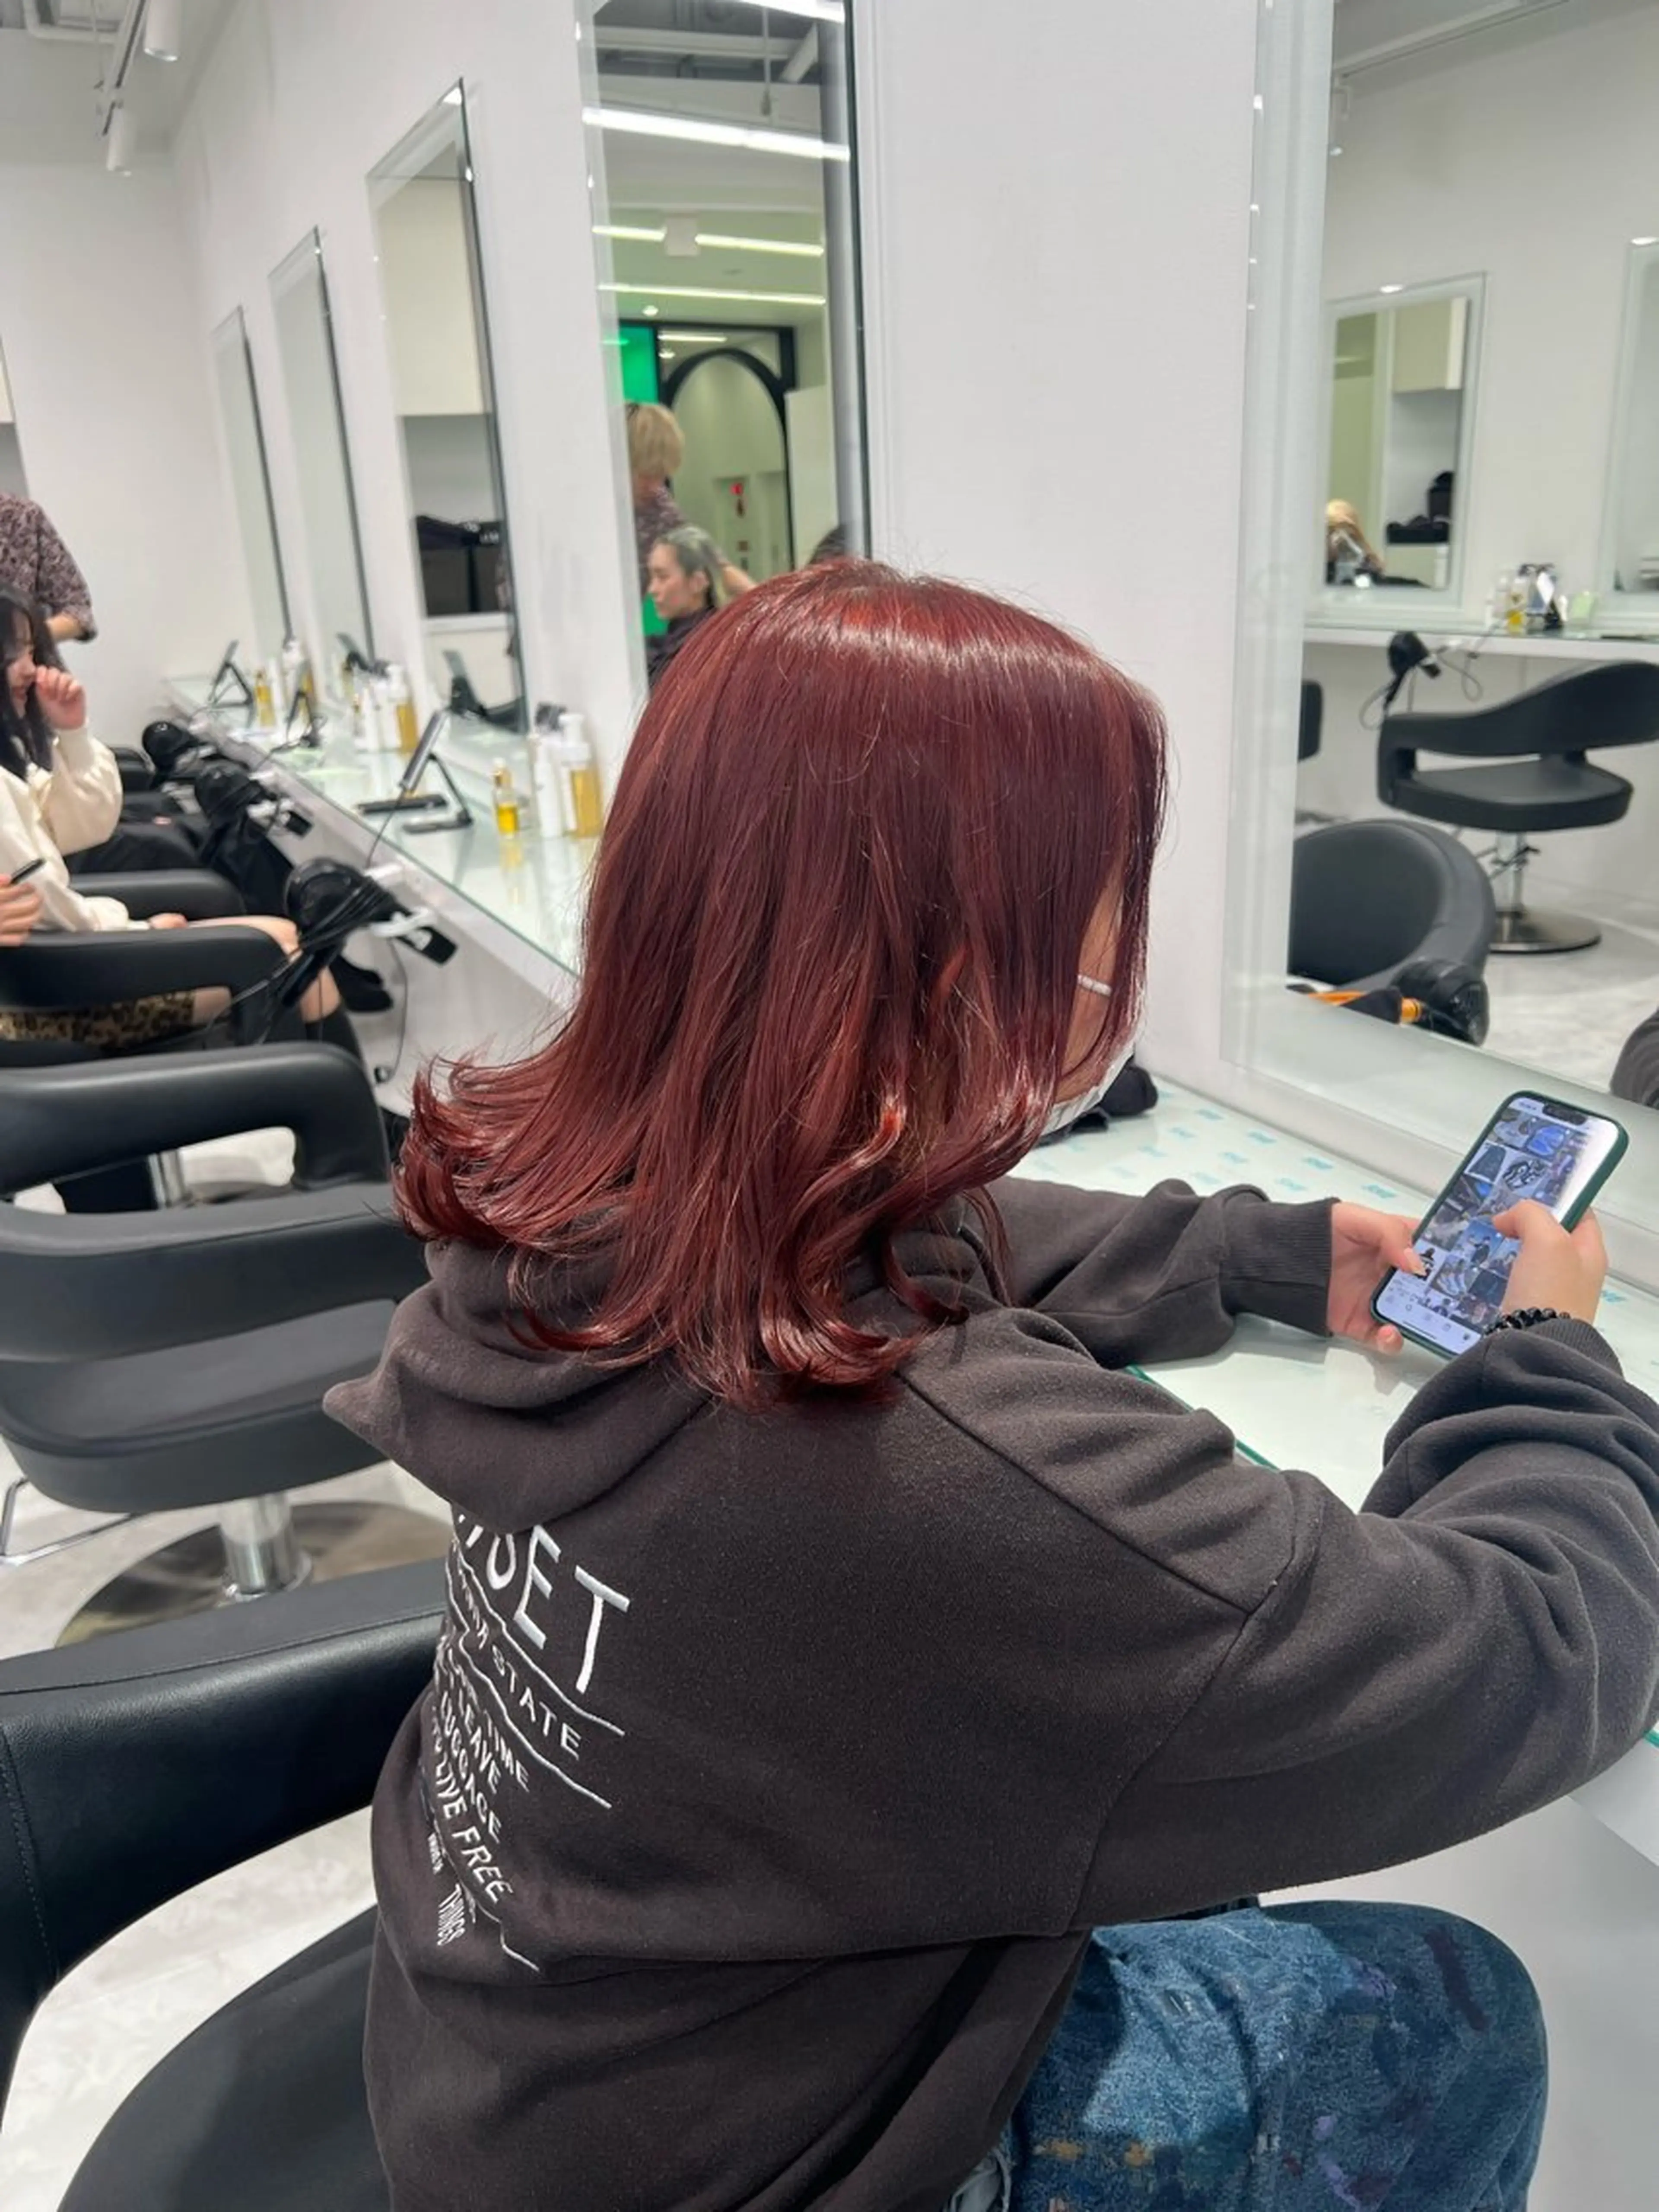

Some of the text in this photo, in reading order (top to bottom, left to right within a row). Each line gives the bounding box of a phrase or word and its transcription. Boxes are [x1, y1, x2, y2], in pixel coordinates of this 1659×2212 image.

[458, 1688, 502, 1794] LEAVE
[492, 1644, 582, 1761] STATE
[435, 1751, 468, 1819] LIVE
[483, 1709, 530, 1793] TIME
[451, 1826, 514, 1904] FREE
